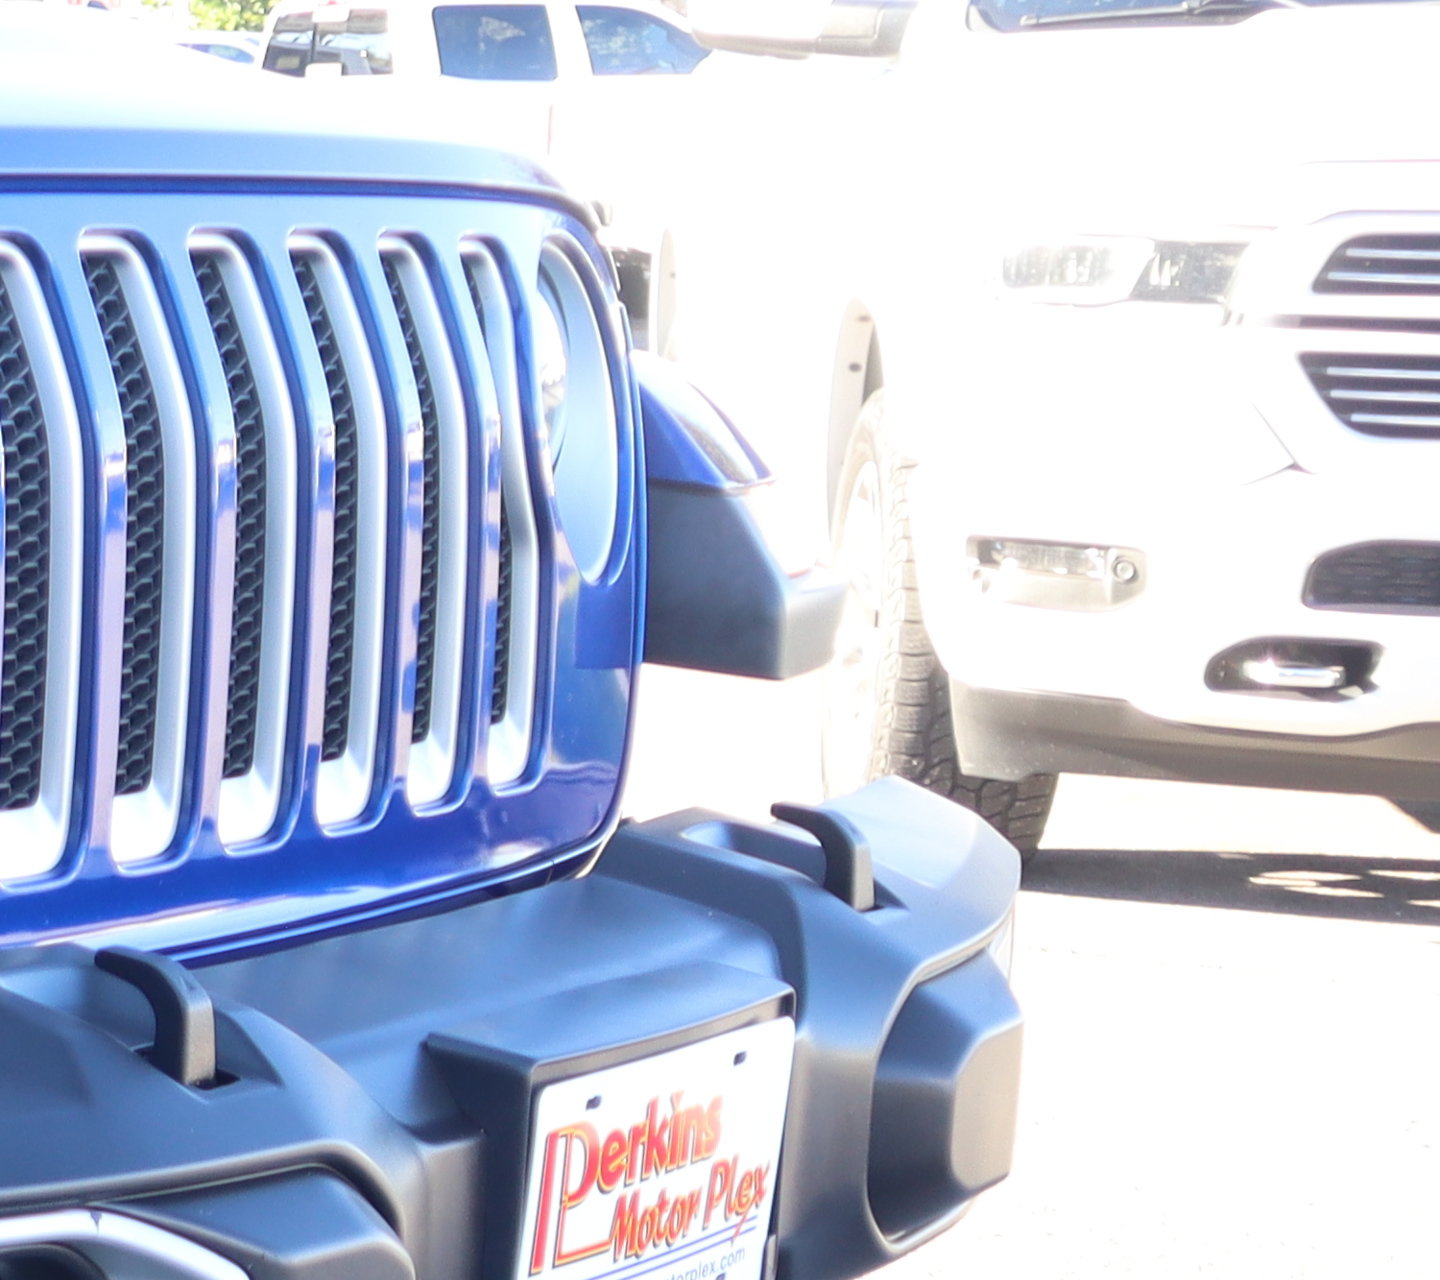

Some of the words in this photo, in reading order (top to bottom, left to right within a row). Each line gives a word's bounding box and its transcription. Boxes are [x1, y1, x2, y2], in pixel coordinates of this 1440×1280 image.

[528, 1090, 723, 1277] Perkins
[610, 1184, 701, 1263] Motor
[702, 1153, 771, 1247] Plex
